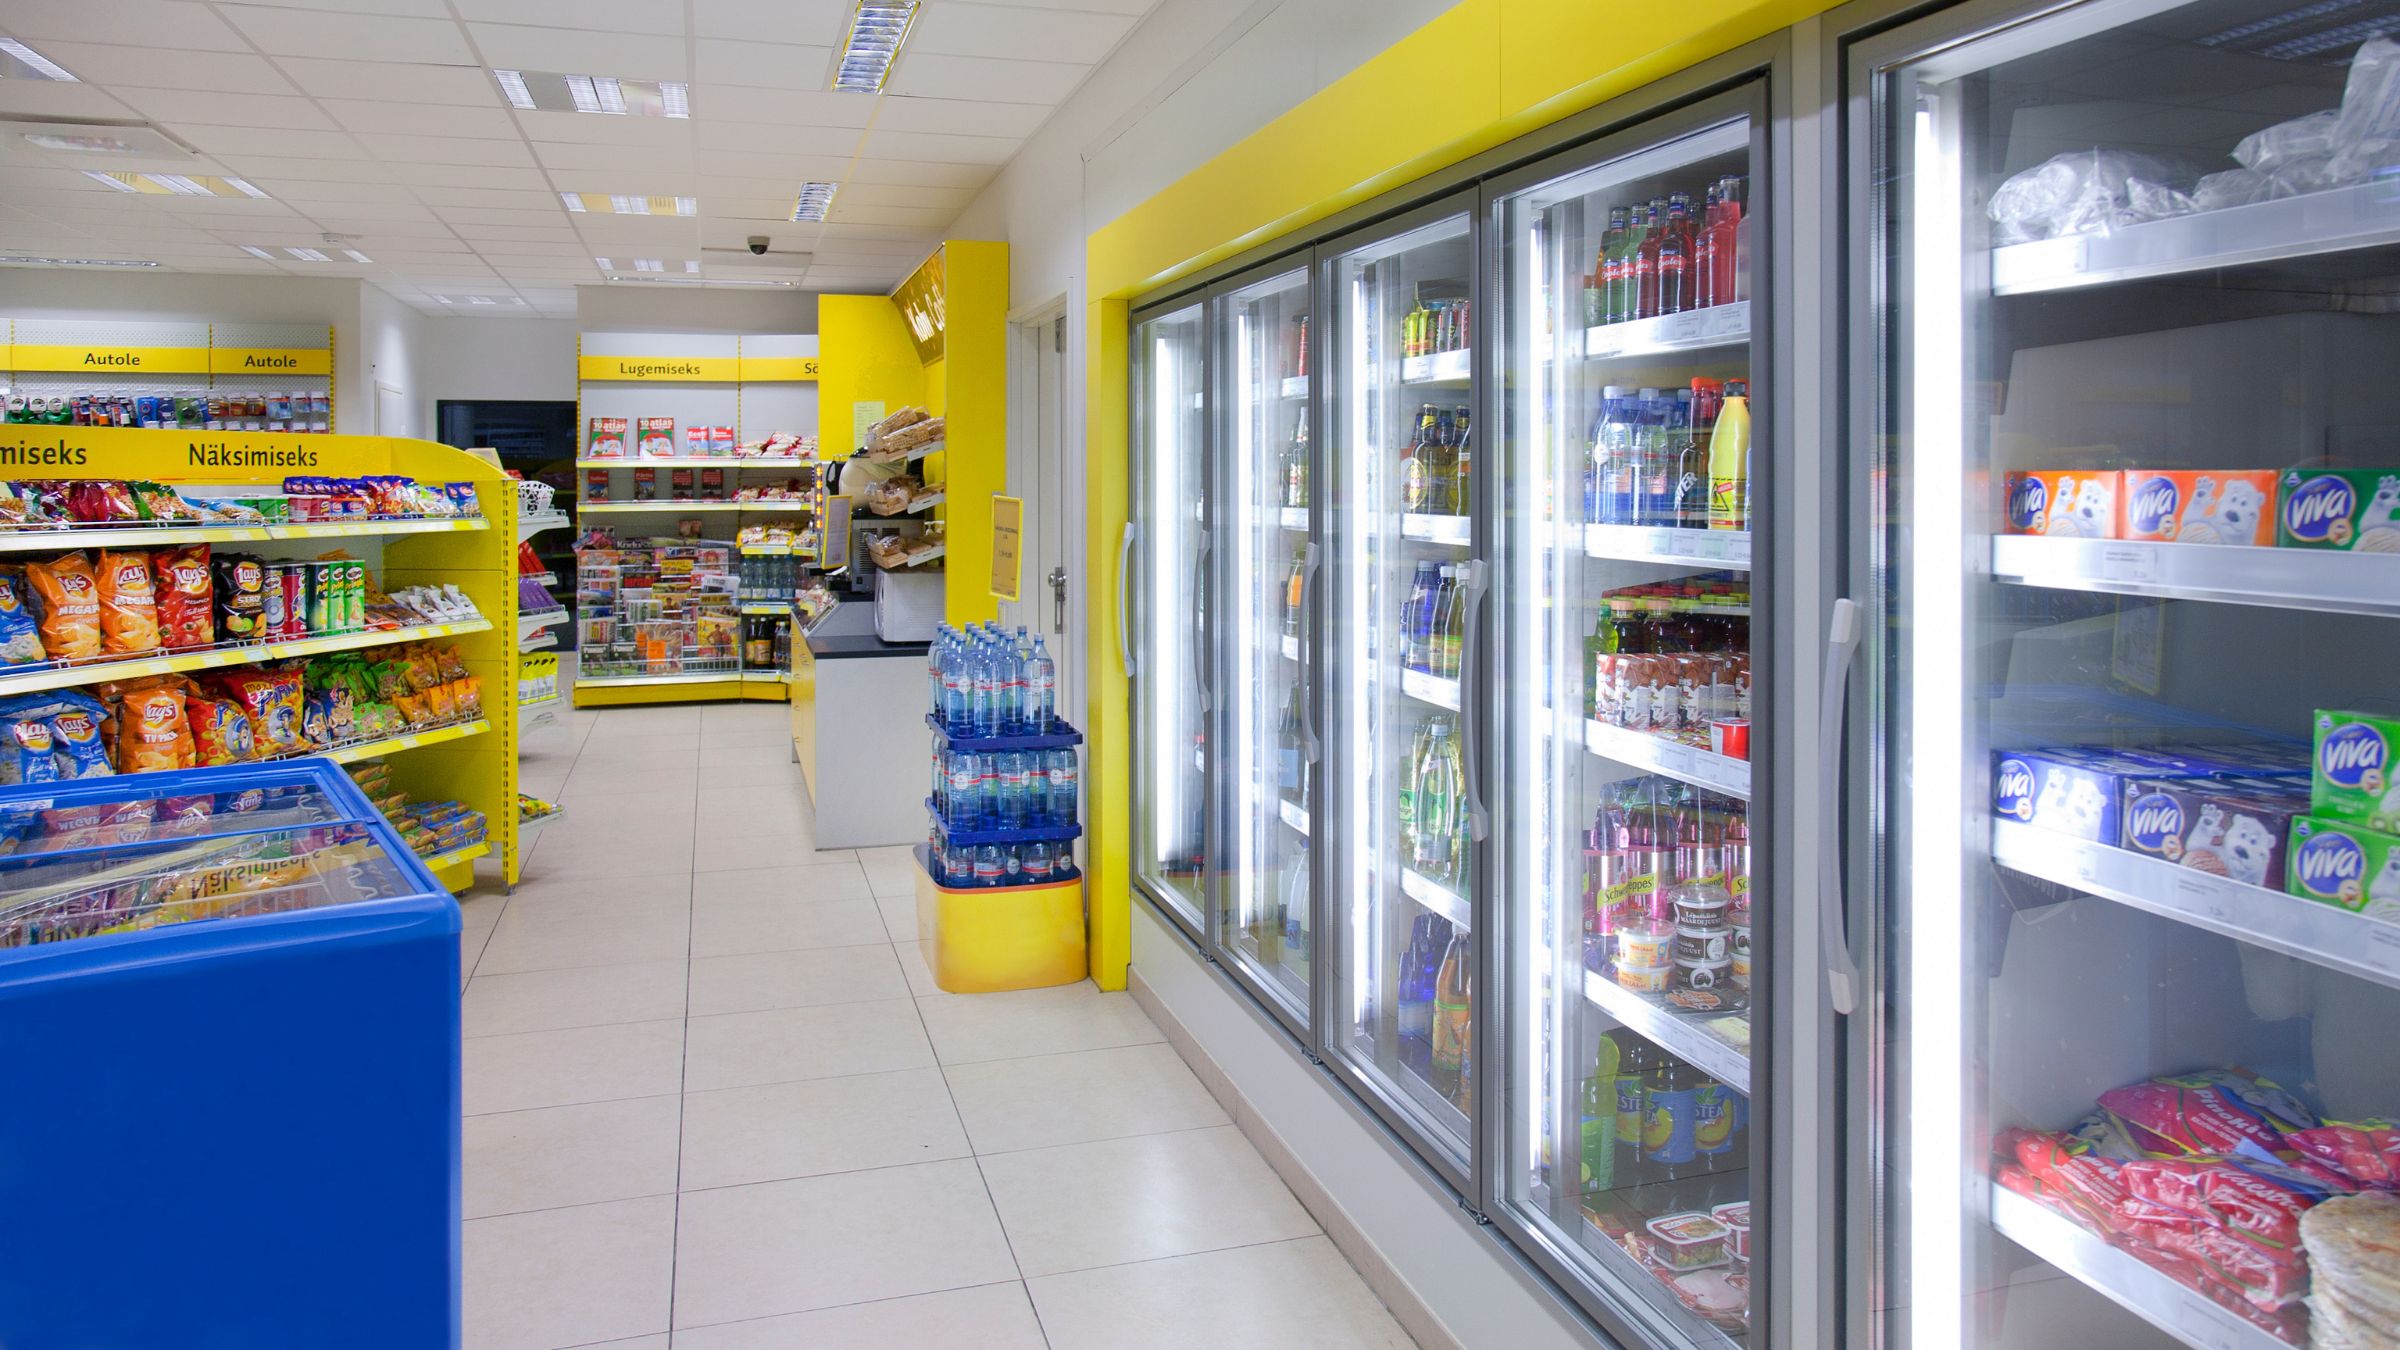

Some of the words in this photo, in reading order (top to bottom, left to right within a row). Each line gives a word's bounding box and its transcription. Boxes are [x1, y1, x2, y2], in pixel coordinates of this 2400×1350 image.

[84, 352, 141, 366] Autole
[244, 355, 298, 368] Autole
[620, 362, 701, 377] Lugemiseks
[188, 442, 319, 467] Näksimiseks
